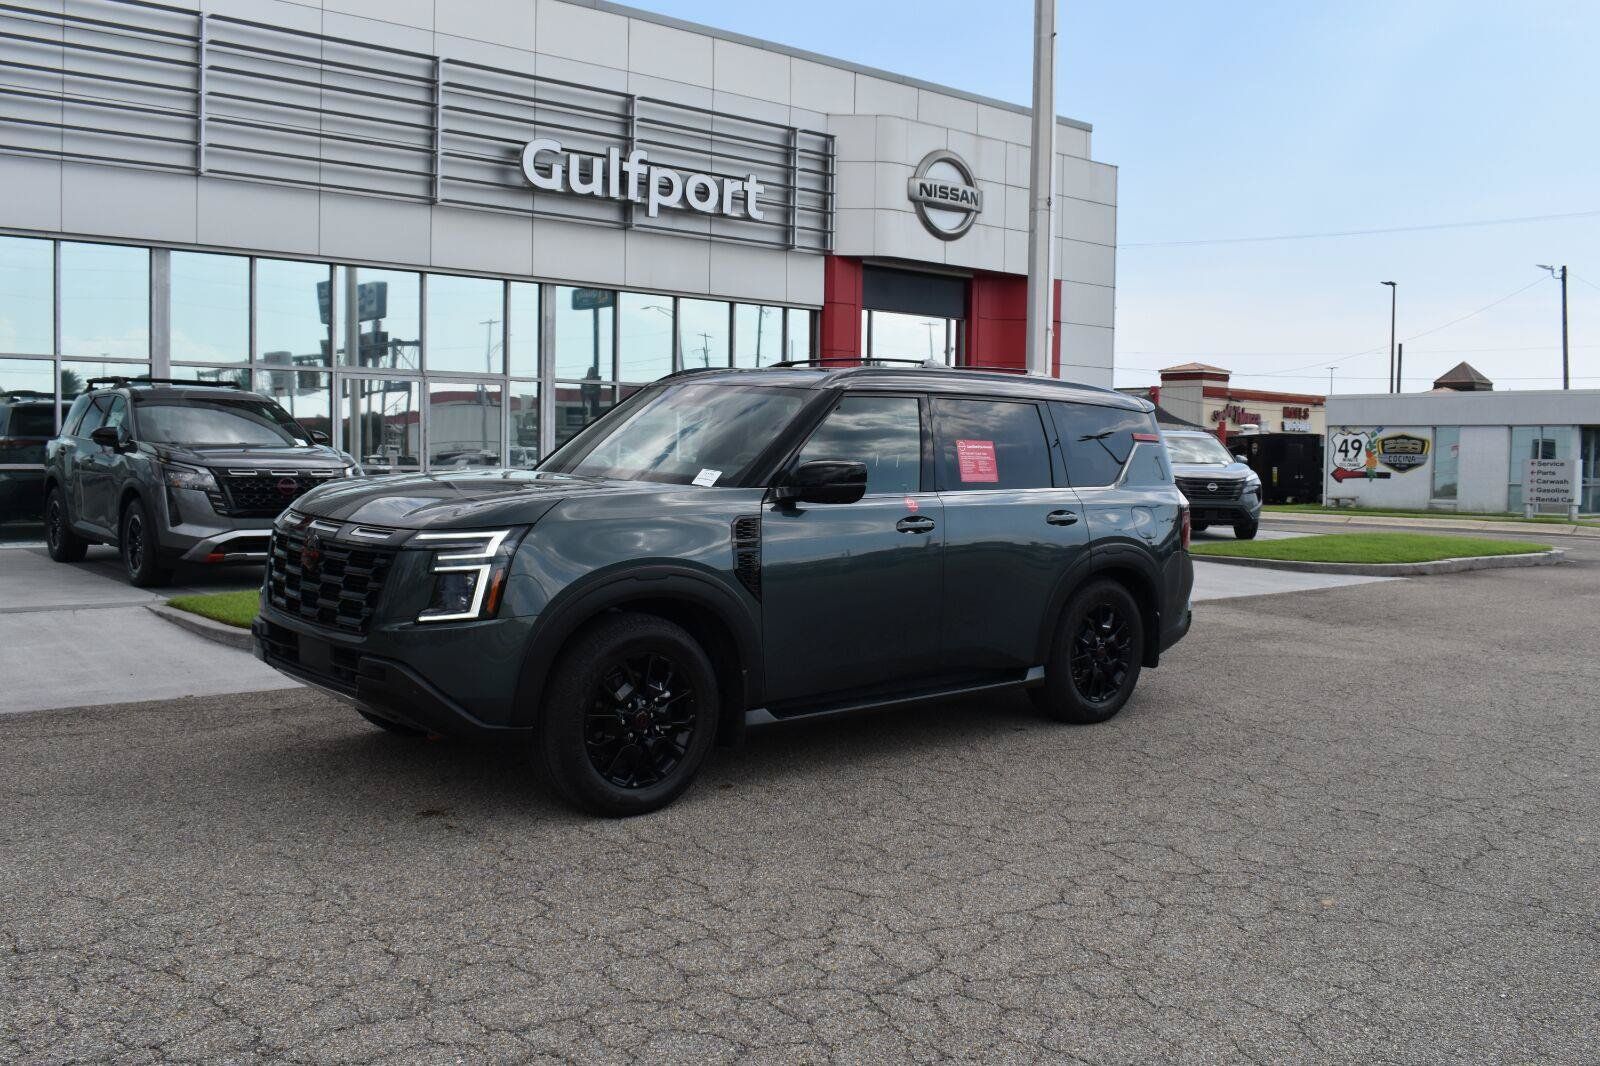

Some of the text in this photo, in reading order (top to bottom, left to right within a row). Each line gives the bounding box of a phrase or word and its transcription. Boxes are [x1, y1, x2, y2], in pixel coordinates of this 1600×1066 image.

[519, 138, 766, 220] Gulfport
[919, 182, 979, 207] NISSAN
[1338, 438, 1363, 459] 49
